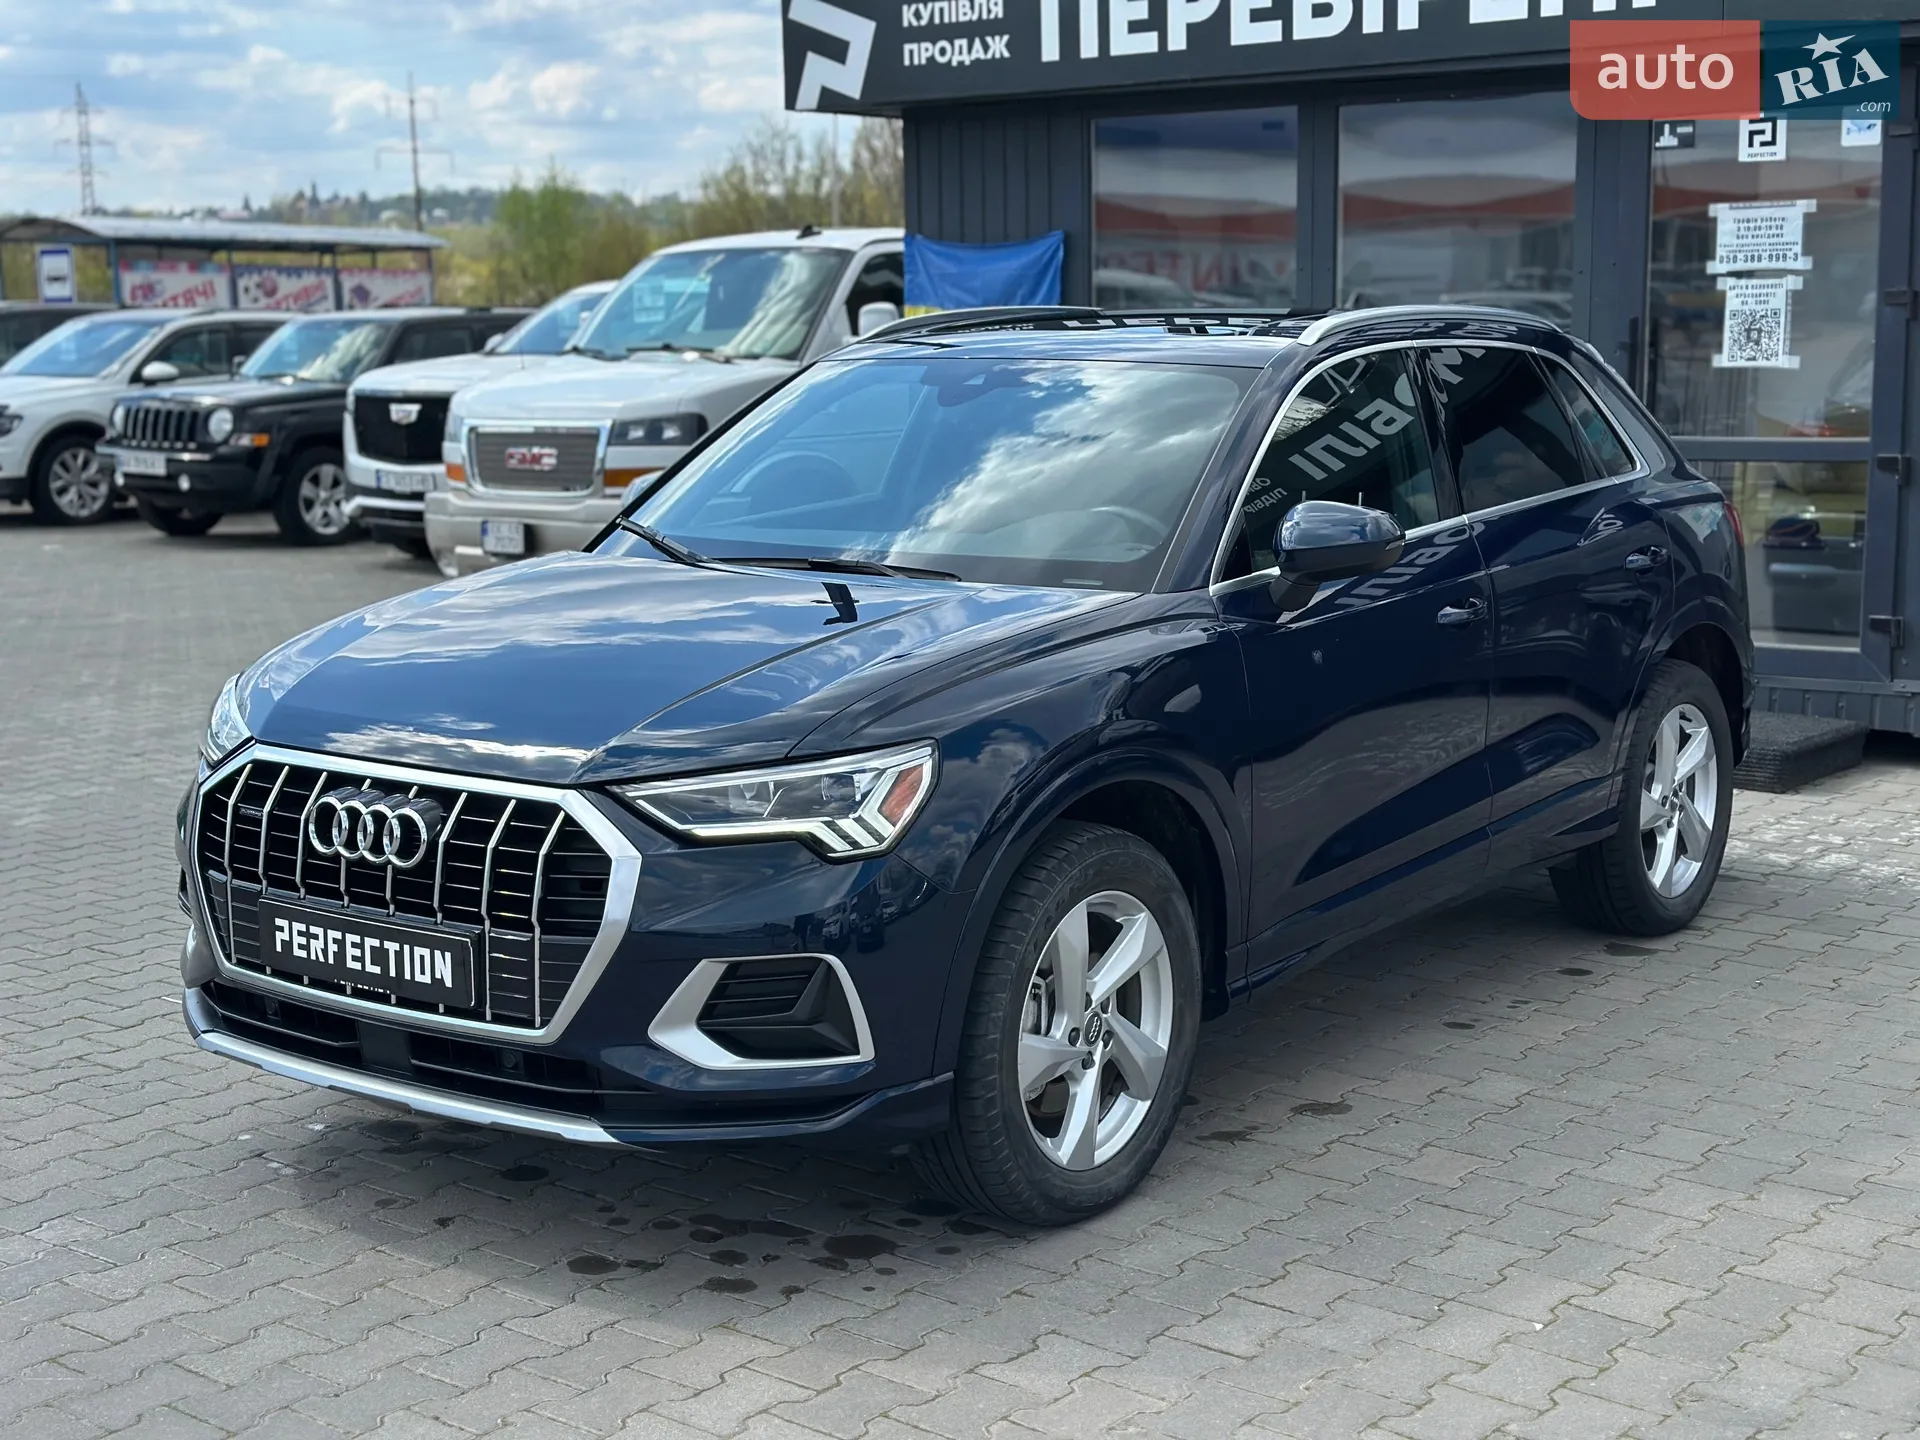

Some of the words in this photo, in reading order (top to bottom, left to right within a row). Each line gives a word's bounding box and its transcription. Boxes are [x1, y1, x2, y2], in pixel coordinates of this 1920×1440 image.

[902, 0, 1004, 27] КУПІВЛЯ
[903, 34, 1011, 67] ПРОДАЖ
[1719, 252, 1799, 264] 050-388-999-3
[506, 447, 558, 471] GMC
[275, 917, 452, 988] PERFECTION
